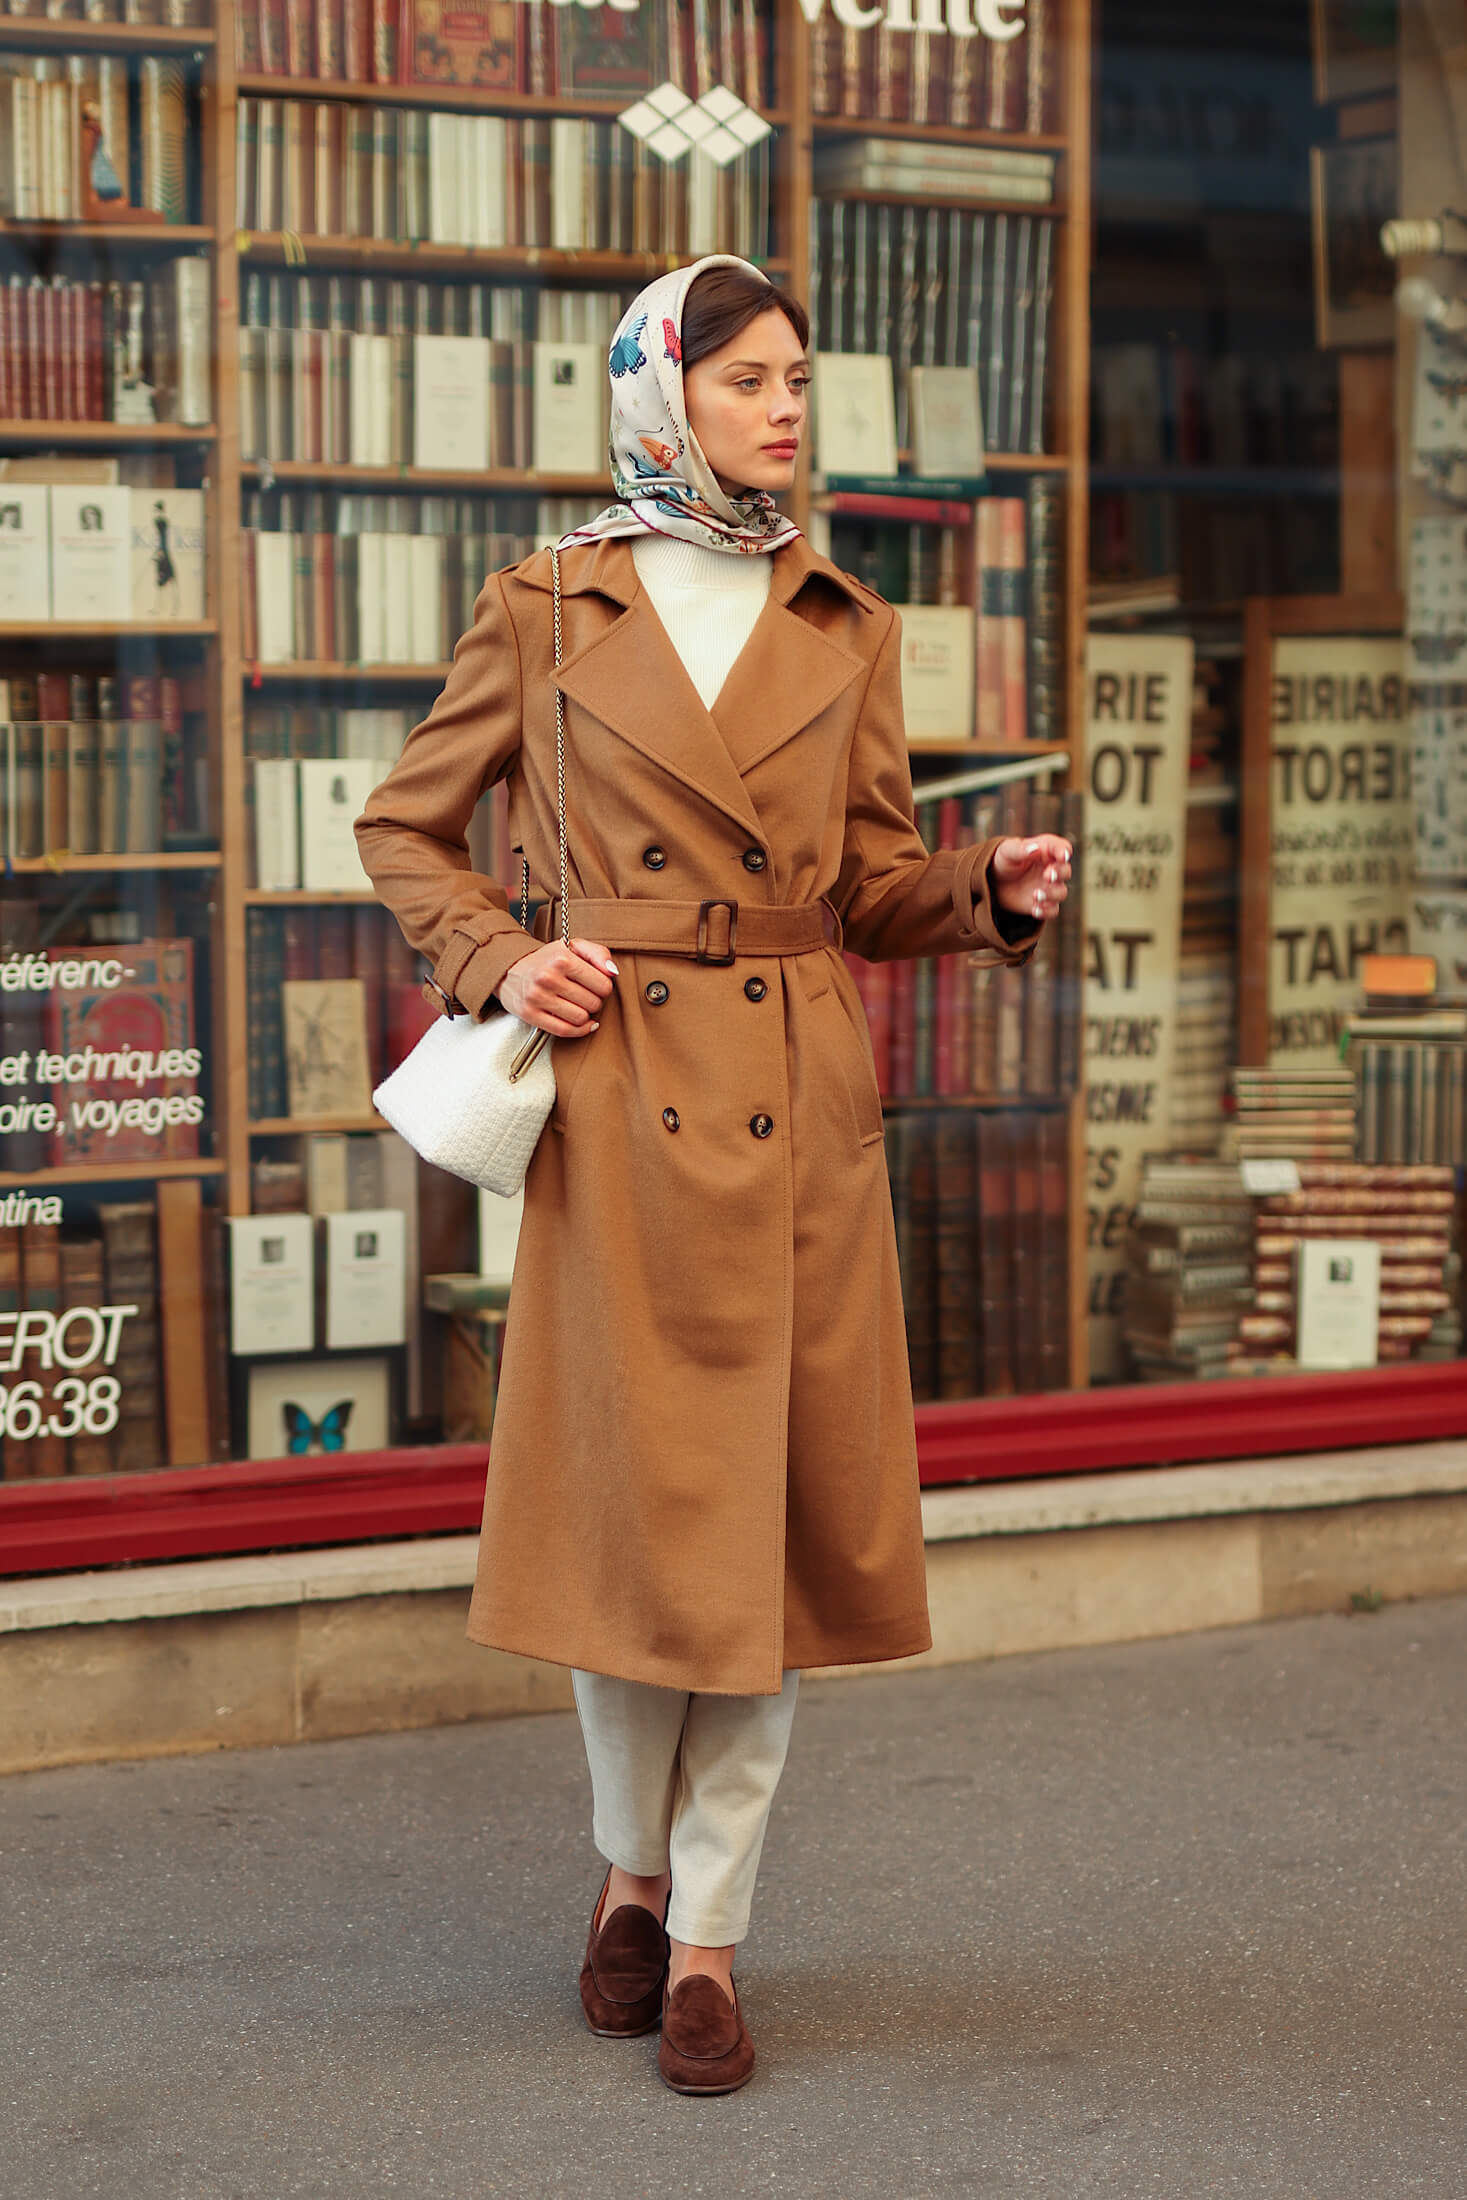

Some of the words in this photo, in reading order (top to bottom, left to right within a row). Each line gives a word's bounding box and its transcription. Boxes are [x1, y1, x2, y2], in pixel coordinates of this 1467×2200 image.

[1093, 673, 1168, 723] RIE
[1091, 745, 1165, 804] OT
[0, 952, 136, 991] éférenc-
[0, 1051, 31, 1085] et
[36, 1043, 202, 1088] techniques
[0, 1096, 66, 1136] oire,
[71, 1095, 205, 1136] voyages
[0, 1190, 64, 1227] tina
[0, 1375, 121, 1440] 6.38
